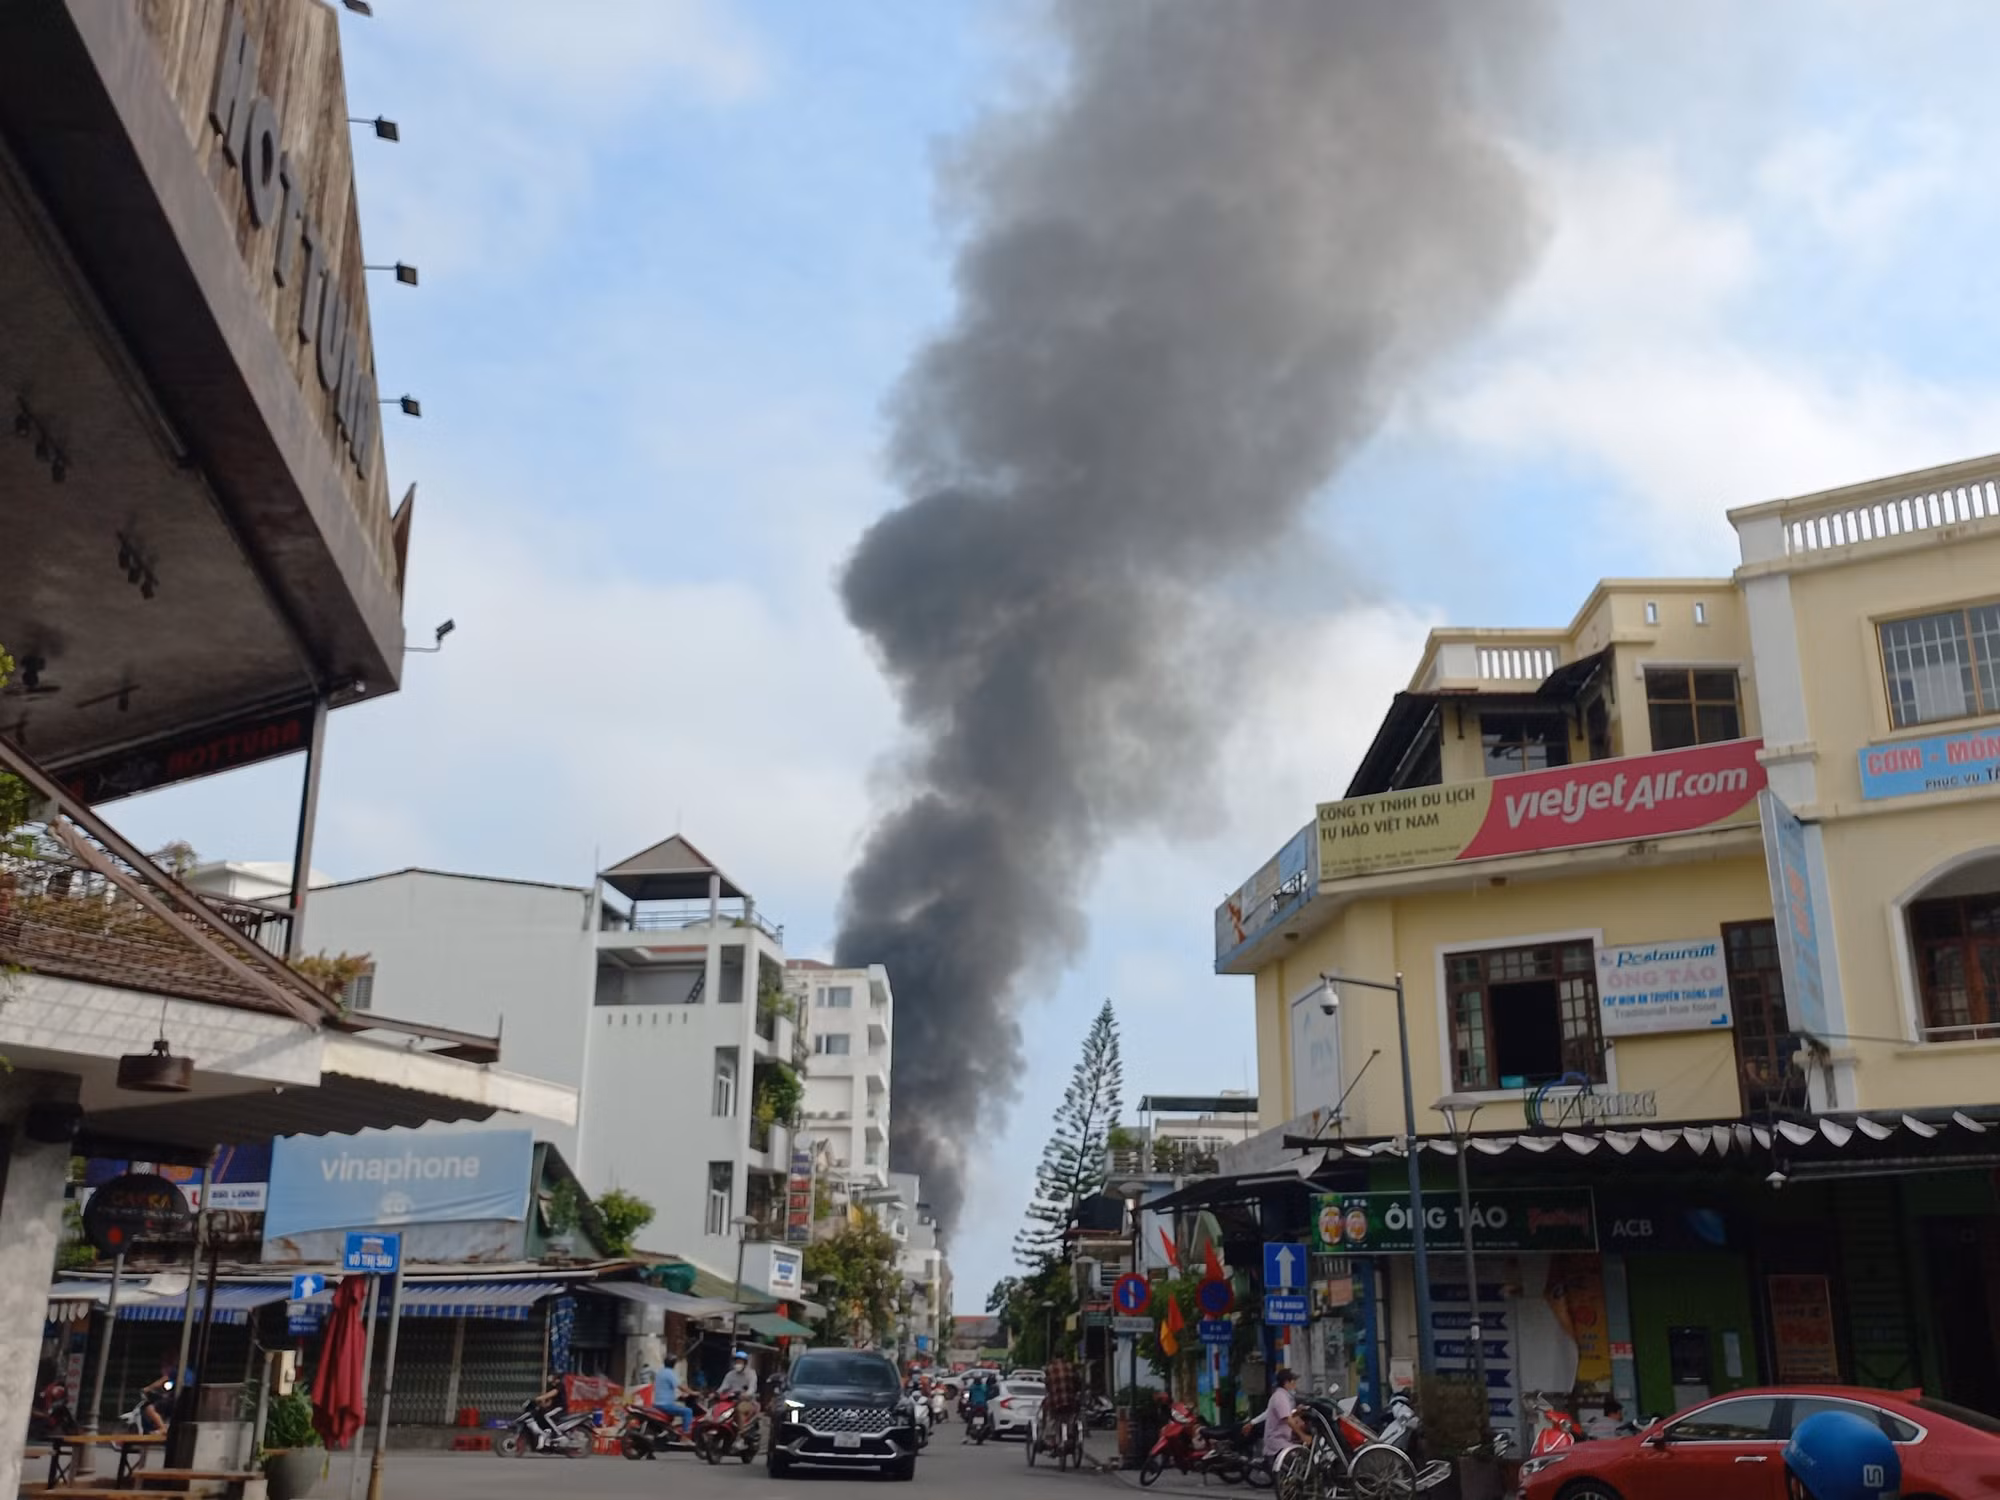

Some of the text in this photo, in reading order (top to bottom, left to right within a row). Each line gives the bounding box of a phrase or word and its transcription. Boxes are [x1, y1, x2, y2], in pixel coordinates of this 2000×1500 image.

[1361, 802, 1375, 816] TY
[1380, 798, 1416, 813] TNHH
[1422, 792, 1441, 806] DU
[1446, 787, 1475, 808] LỊCH
[1406, 812, 1439, 829] NAM
[321, 1151, 480, 1184] vinaphone
[1612, 1219, 1653, 1237] ACB
